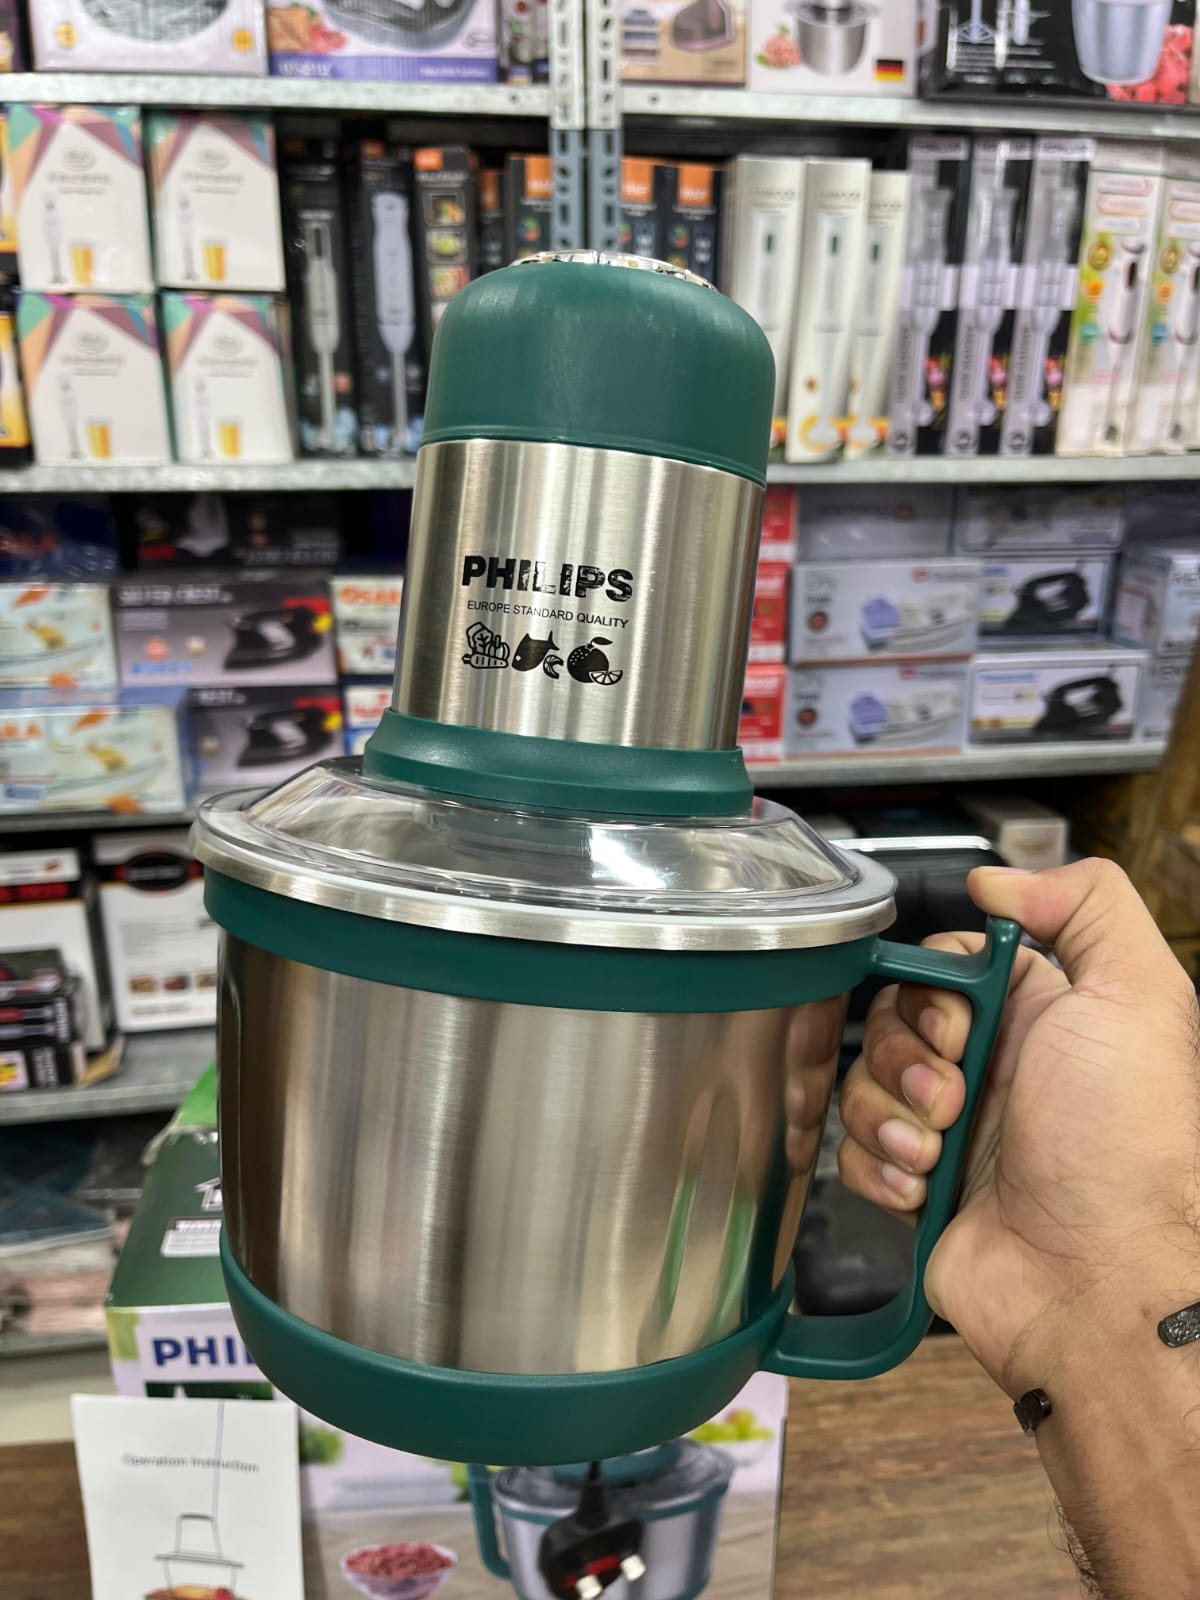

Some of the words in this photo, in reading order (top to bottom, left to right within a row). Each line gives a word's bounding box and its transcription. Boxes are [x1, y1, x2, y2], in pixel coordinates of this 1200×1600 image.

[461, 555, 634, 602] PHILIPS
[467, 600, 510, 614] EUROPE
[513, 604, 573, 621] STANDARD
[576, 612, 629, 629] QUALITY
